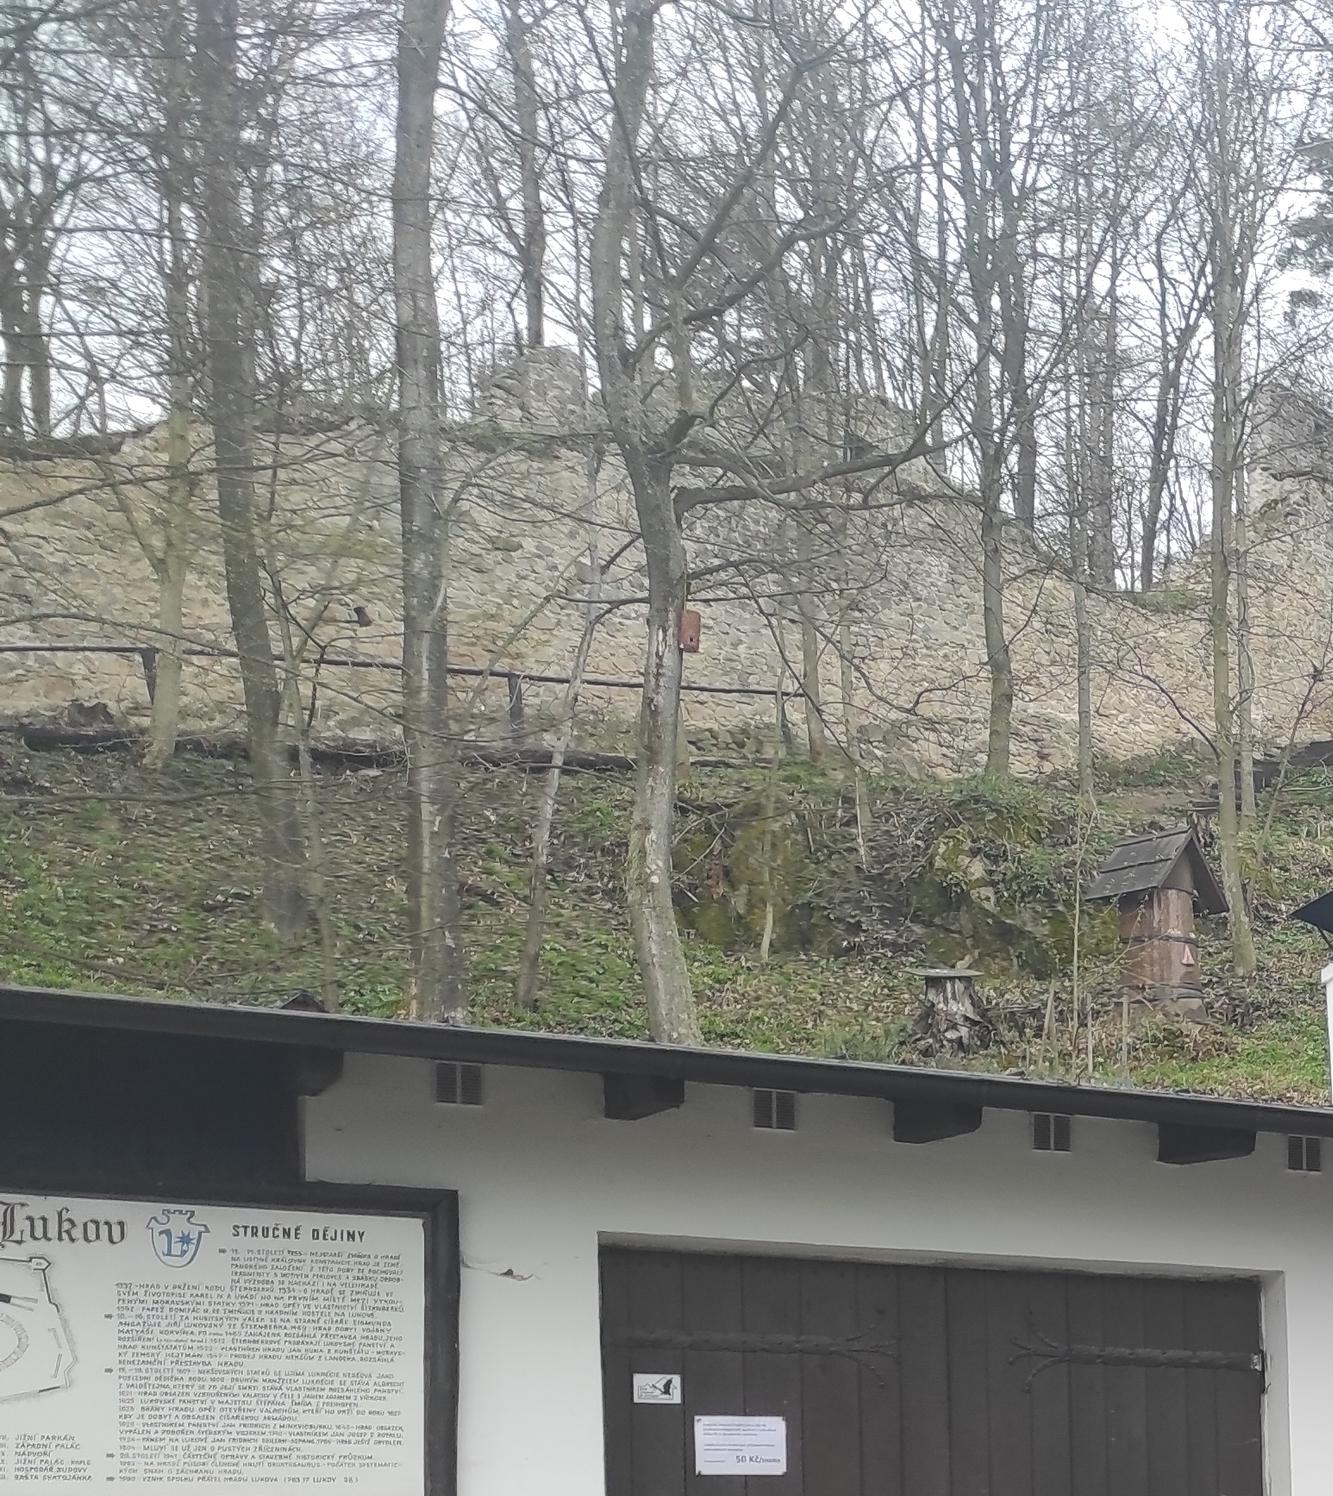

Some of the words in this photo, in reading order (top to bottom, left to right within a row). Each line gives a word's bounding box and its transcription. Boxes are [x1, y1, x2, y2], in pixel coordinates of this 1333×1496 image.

[0, 1201, 126, 1248] Lukov
[231, 1223, 302, 1240] STRUČNÉ
[312, 1226, 366, 1242] DĚJINY
